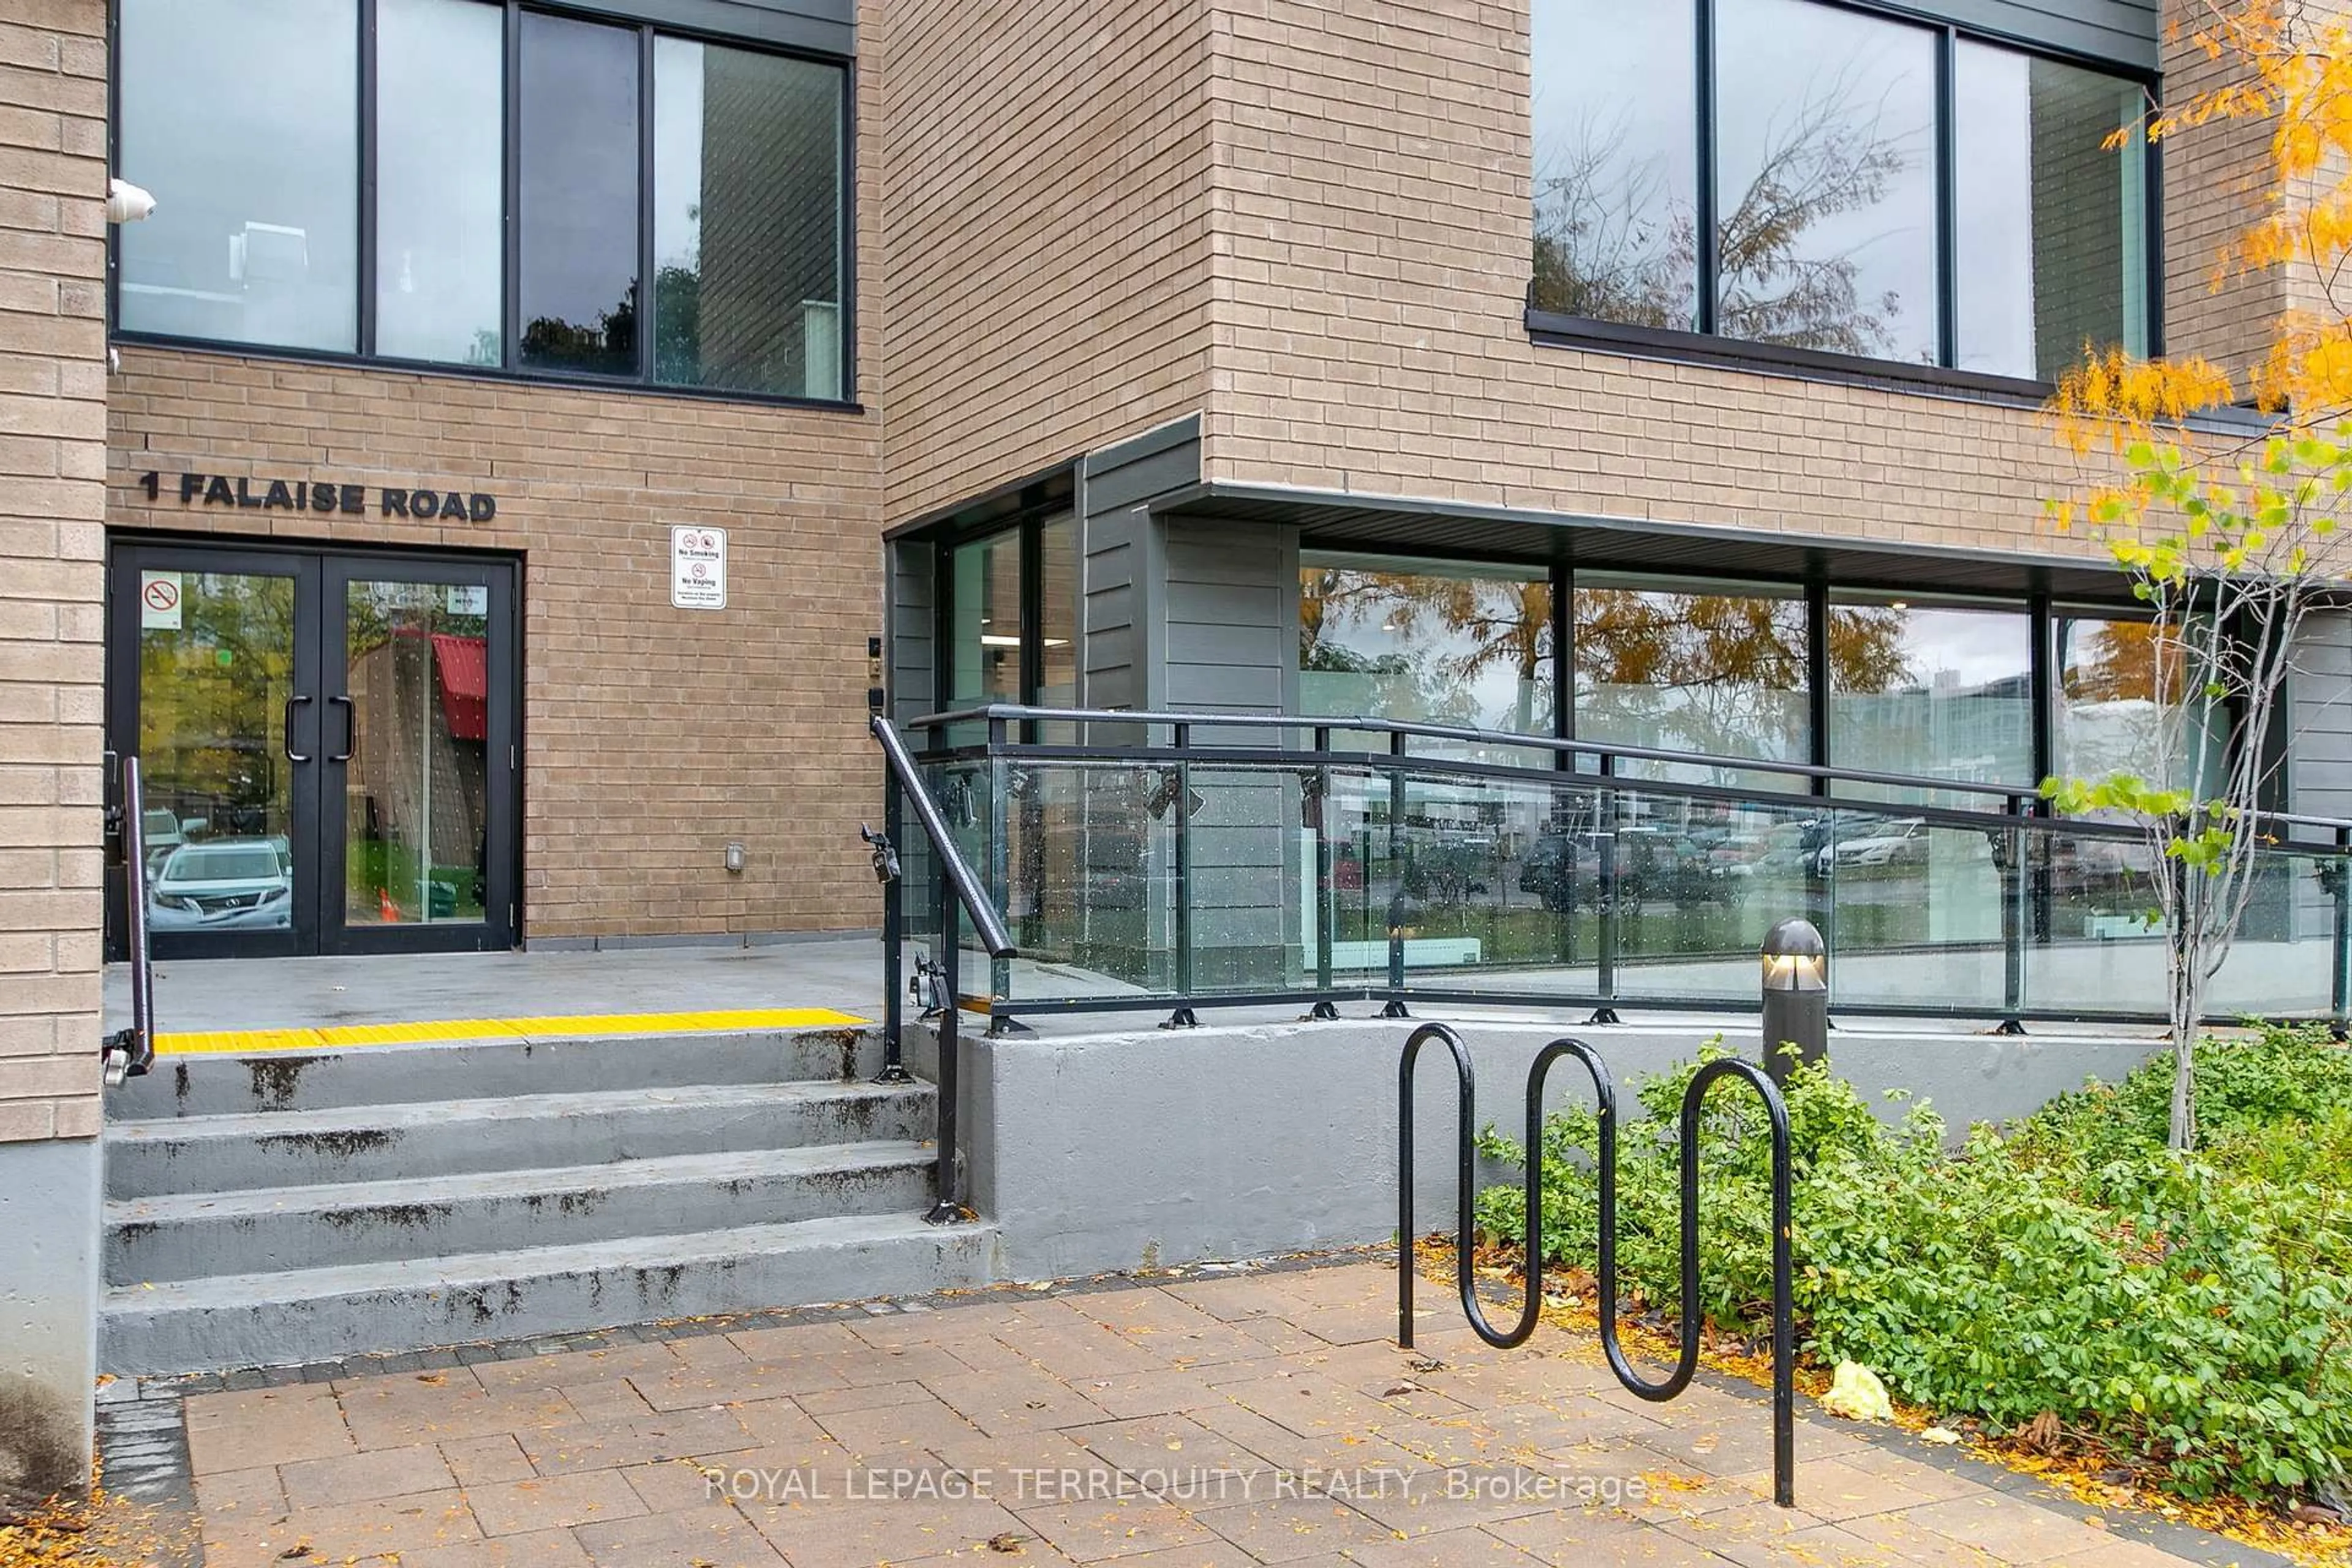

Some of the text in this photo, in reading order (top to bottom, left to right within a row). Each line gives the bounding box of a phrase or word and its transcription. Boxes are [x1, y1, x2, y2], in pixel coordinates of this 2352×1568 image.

[139, 471, 496, 522] 1 FALAISE ROAD
[690, 549, 719, 559] Smoking
[693, 578, 716, 586] Vaping
